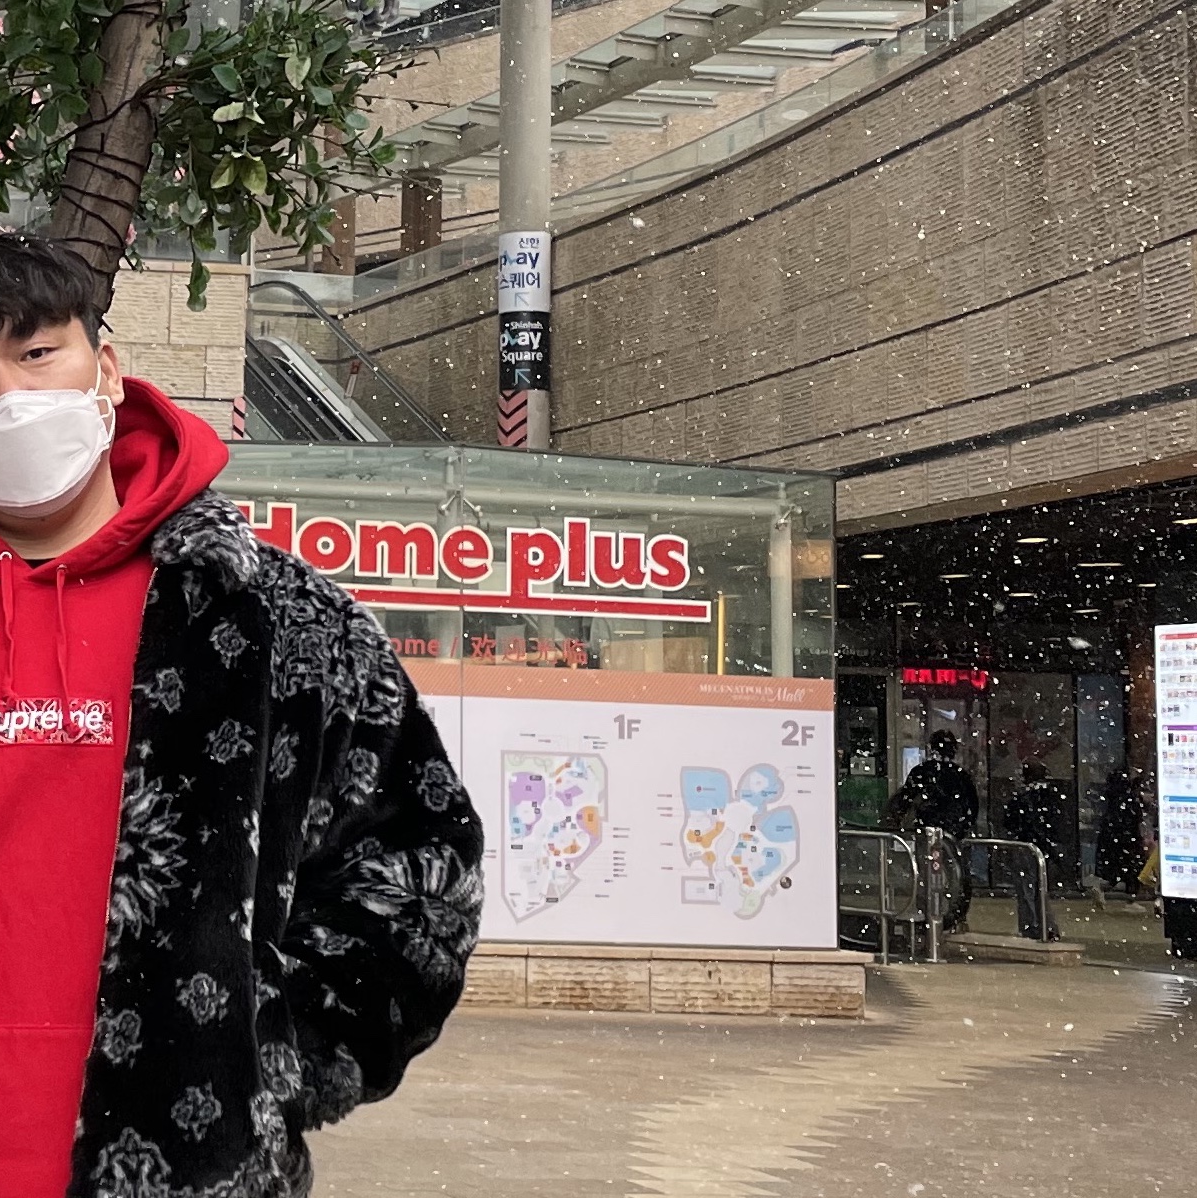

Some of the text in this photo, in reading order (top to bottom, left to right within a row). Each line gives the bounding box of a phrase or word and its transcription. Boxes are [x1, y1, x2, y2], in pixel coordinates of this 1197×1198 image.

[518, 237, 540, 249] 신한
[499, 271, 541, 290] 스퀘어
[502, 350, 544, 365] Square
[238, 501, 691, 598] Home plus
[470, 633, 589, 666] 欢迎光临
[768, 686, 806, 703] Mall
[613, 713, 816, 747] 1F 2F
